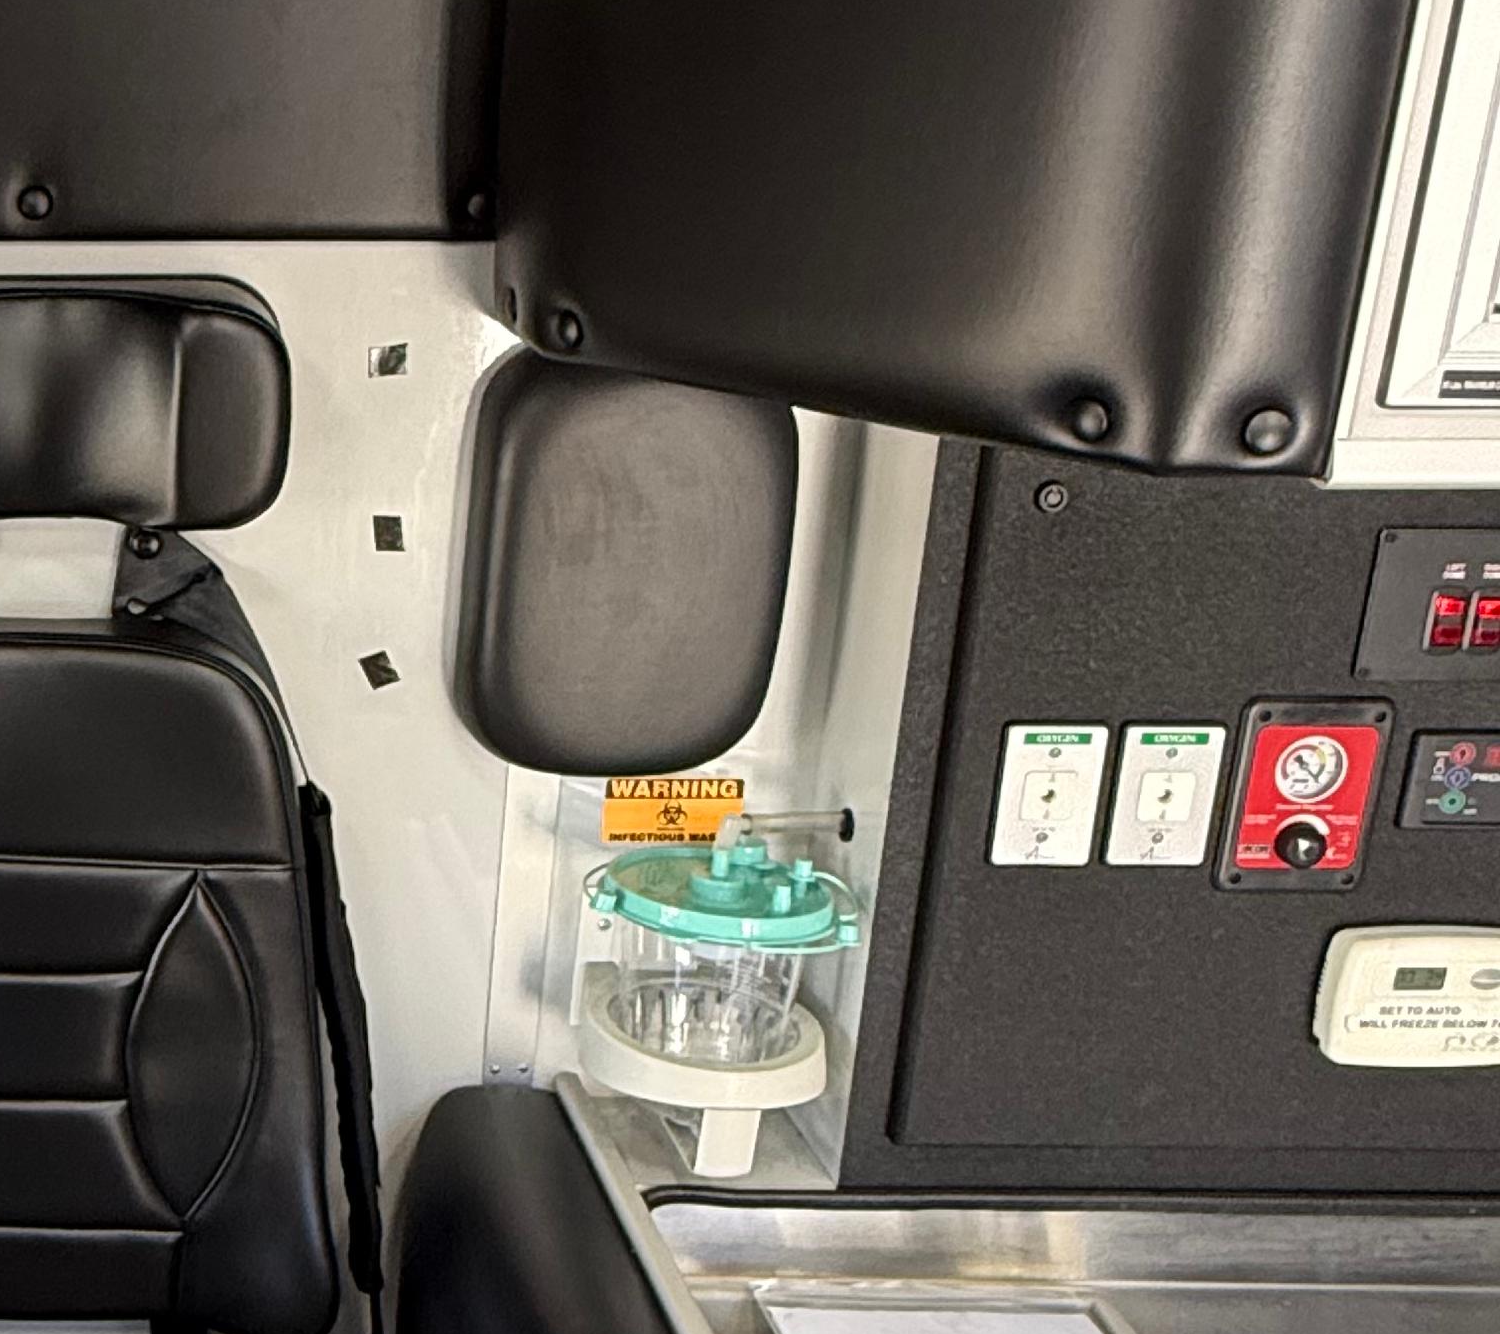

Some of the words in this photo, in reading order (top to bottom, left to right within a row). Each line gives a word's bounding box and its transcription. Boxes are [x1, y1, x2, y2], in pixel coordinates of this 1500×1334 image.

[611, 779, 739, 798] WARNING
[608, 833, 685, 842] INFECTIOUS
[689, 833, 717, 842] WAS
[1379, 1006, 1403, 1015] SET
[1407, 1006, 1423, 1015] TO
[1426, 1006, 1462, 1015] AUTO
[1359, 1019, 1387, 1028] WILL
